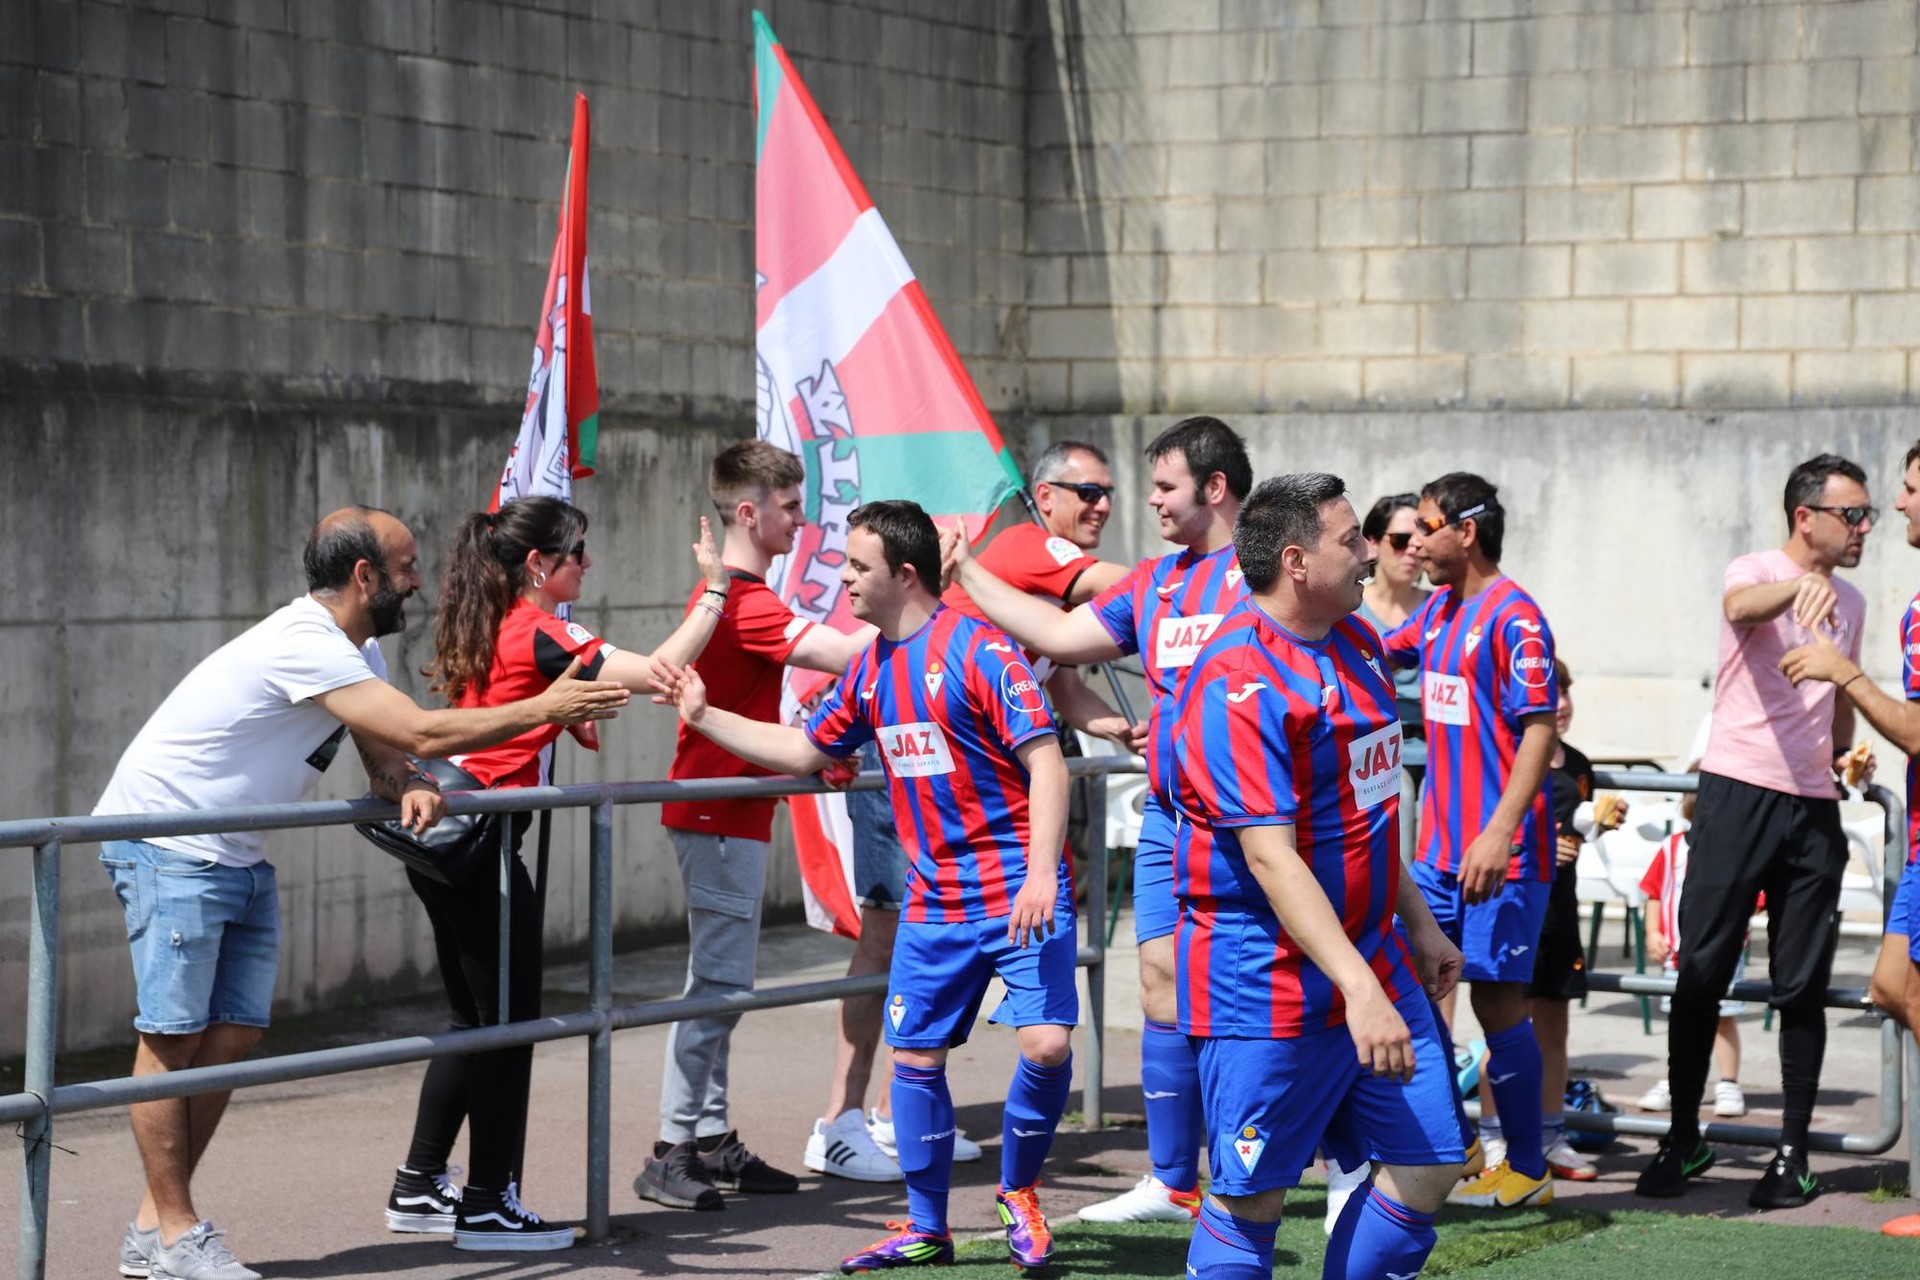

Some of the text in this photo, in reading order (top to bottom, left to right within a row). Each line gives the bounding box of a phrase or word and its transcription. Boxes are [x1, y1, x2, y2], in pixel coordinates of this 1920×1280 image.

[1165, 623, 1209, 649] JAZ
[1431, 681, 1458, 705] JAZ
[891, 731, 936, 758] JAZ
[1355, 732, 1401, 780] JAZ
